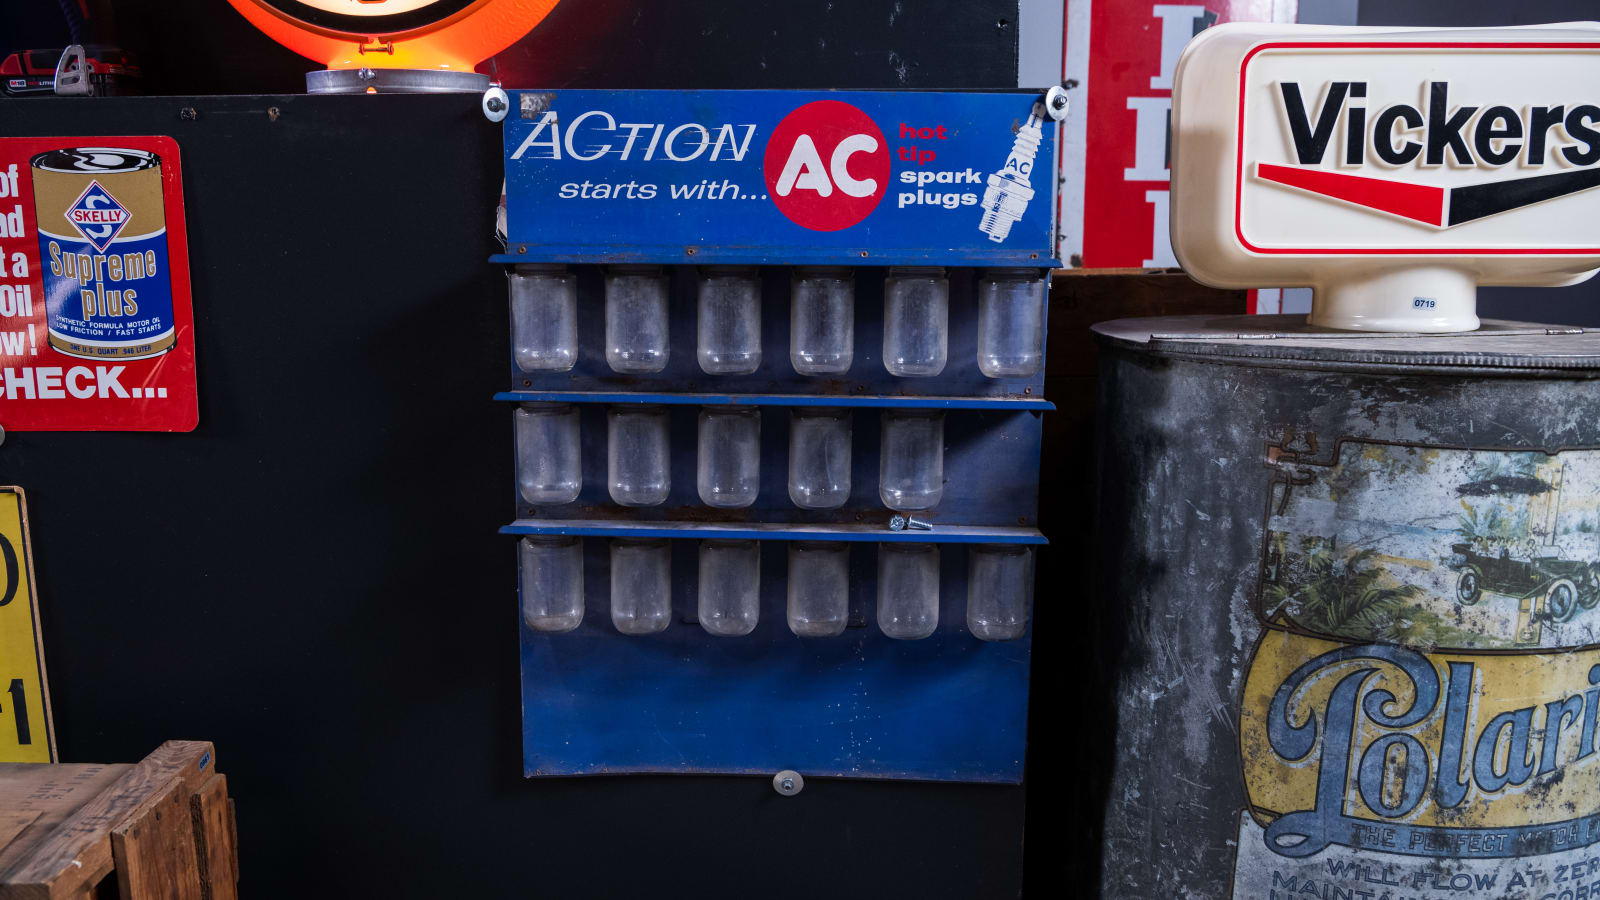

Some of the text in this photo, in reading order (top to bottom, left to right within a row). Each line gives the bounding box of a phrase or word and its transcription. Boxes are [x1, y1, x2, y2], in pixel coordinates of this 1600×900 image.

[899, 123, 947, 140] hot
[1280, 81, 1600, 167] Vickers
[510, 110, 757, 162] ACTION
[897, 146, 936, 165] tip
[776, 134, 879, 198] AC
[1006, 157, 1031, 175] AC
[900, 168, 983, 185] spark
[558, 180, 767, 200] starts with...
[898, 189, 978, 209] plugs
[74, 210, 121, 222] SKELLY
[11, 252, 29, 278] a
[49, 240, 157, 286] Supreme
[0, 284, 33, 317] Oil
[80, 282, 138, 321] plus
[1414, 299, 1435, 308] 0719
[55, 314, 86, 327] SYNTHETIC
[127, 320, 150, 328] MOTOR
[56, 322, 68, 330] LOW
[70, 326, 104, 336] FRICTION
[116, 328, 135, 336] FAST
[138, 324, 161, 334] STARTS
[0, 324, 37, 356] w!
[136, 344, 151, 353] LITER
[1351, 823, 1396, 848] THE
[1409, 830, 1508, 852] PEFECT
[1327, 856, 1600, 891] WILL FLOW AT ZER
